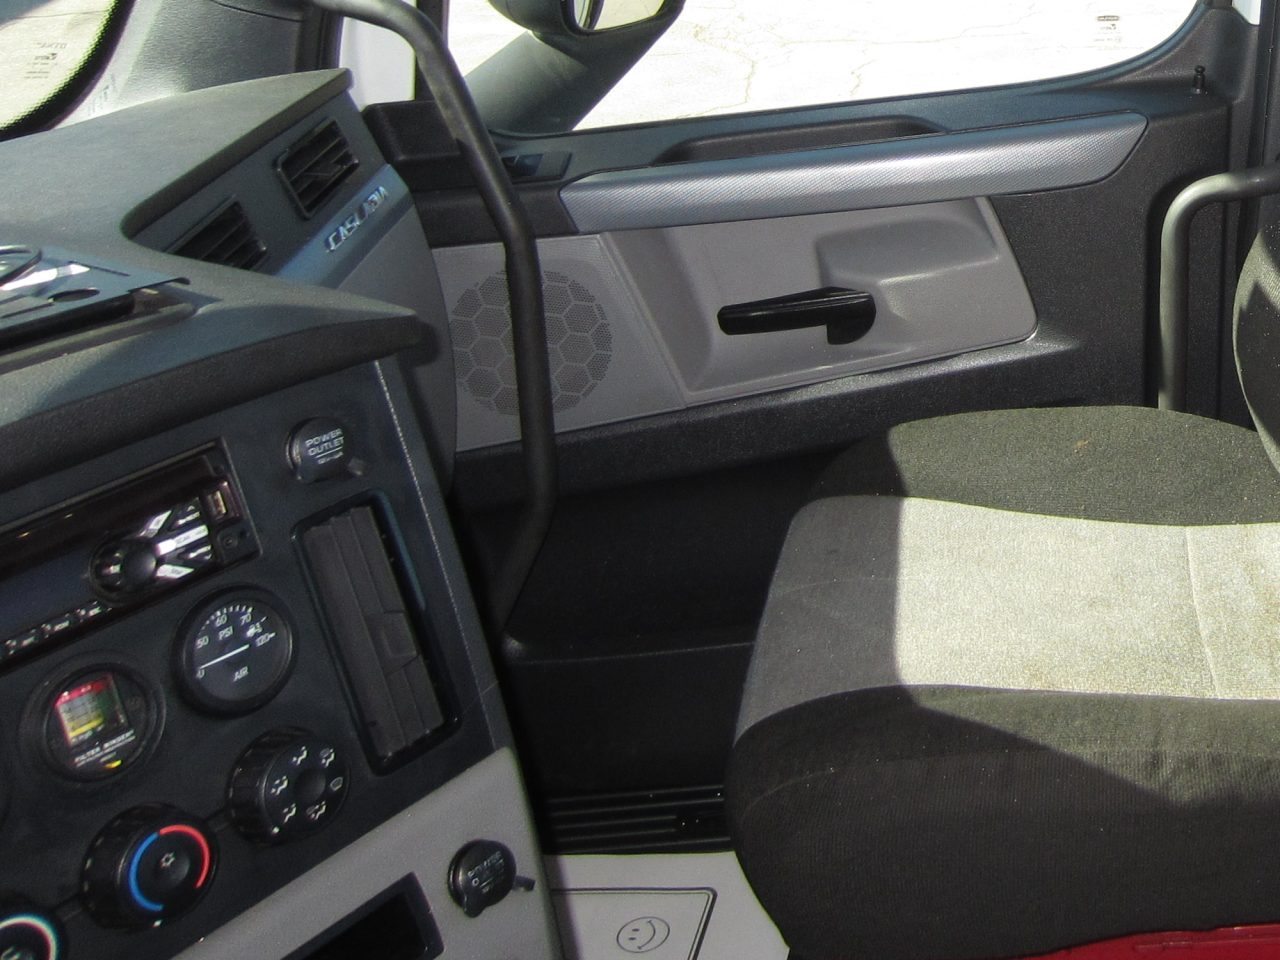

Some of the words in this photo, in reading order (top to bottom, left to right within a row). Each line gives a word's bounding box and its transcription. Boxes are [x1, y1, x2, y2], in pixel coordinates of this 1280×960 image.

[304, 427, 343, 448] POWER
[308, 436, 345, 456] OUTLET
[215, 614, 228, 628] 60
[239, 613, 252, 626] 70
[218, 626, 234, 641] PSI
[195, 635, 209, 650] 50
[232, 666, 250, 682] AIR
